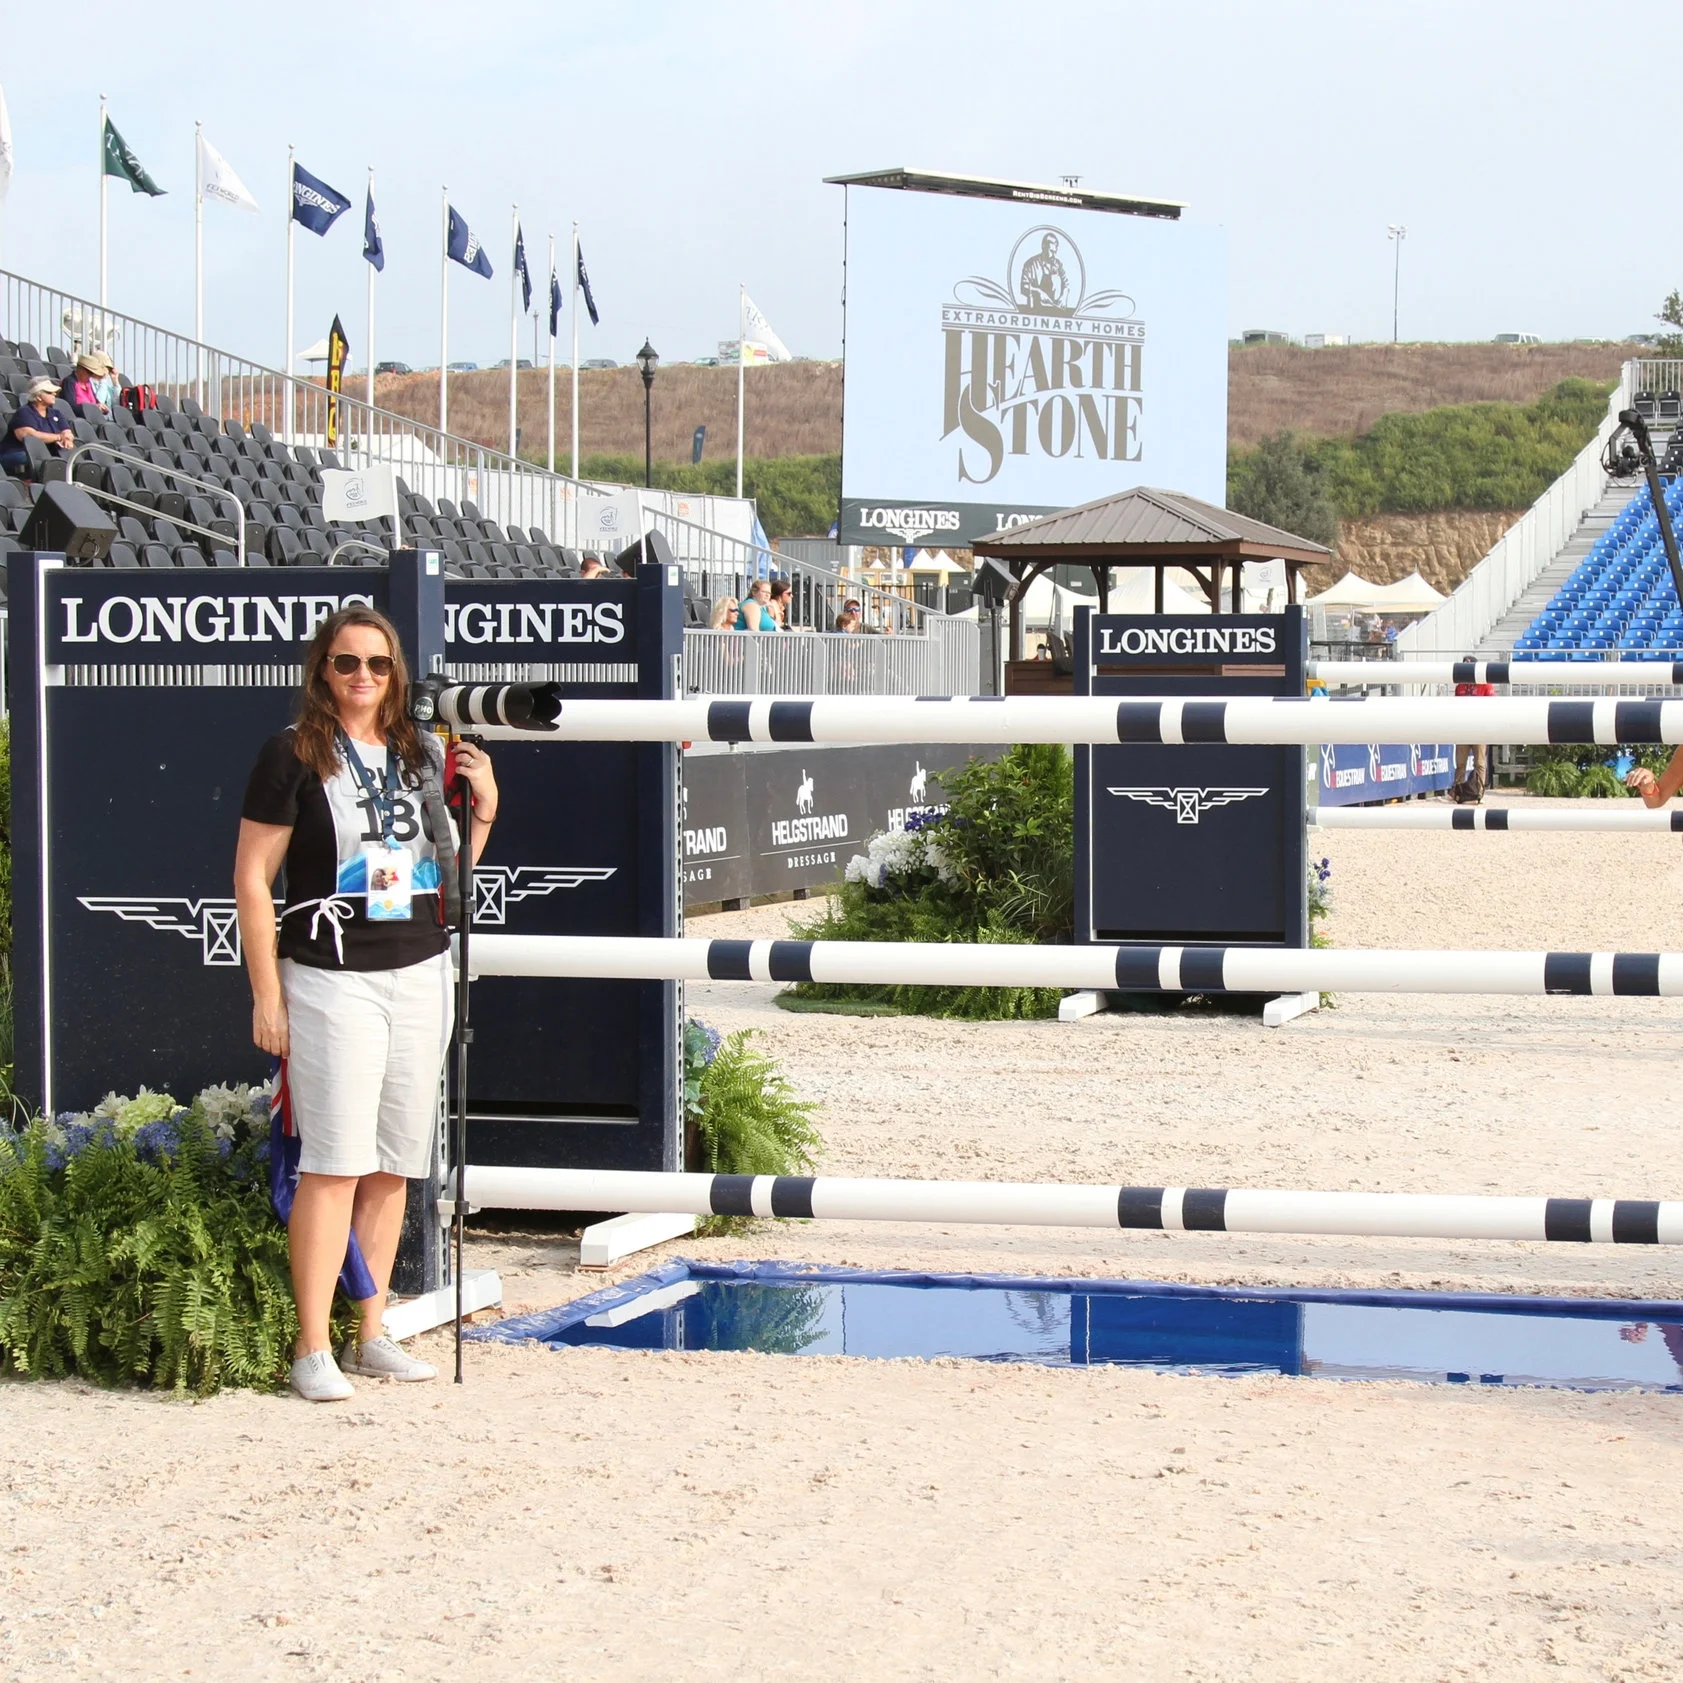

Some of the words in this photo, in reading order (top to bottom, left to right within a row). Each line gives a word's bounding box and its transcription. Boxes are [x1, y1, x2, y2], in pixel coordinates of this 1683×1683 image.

[941, 310, 1084, 332] EXTRAORDINARY
[1091, 323, 1146, 337] HOMES
[939, 328, 1144, 442] HEARTH
[958, 384, 1143, 484] STONE
[859, 508, 960, 530] LONGINES
[61, 593, 374, 643] LONGINE
[1099, 627, 1276, 655] LONGINES
[771, 814, 849, 846] HELGSTRAND
[787, 851, 836, 869] DRESSAGE
